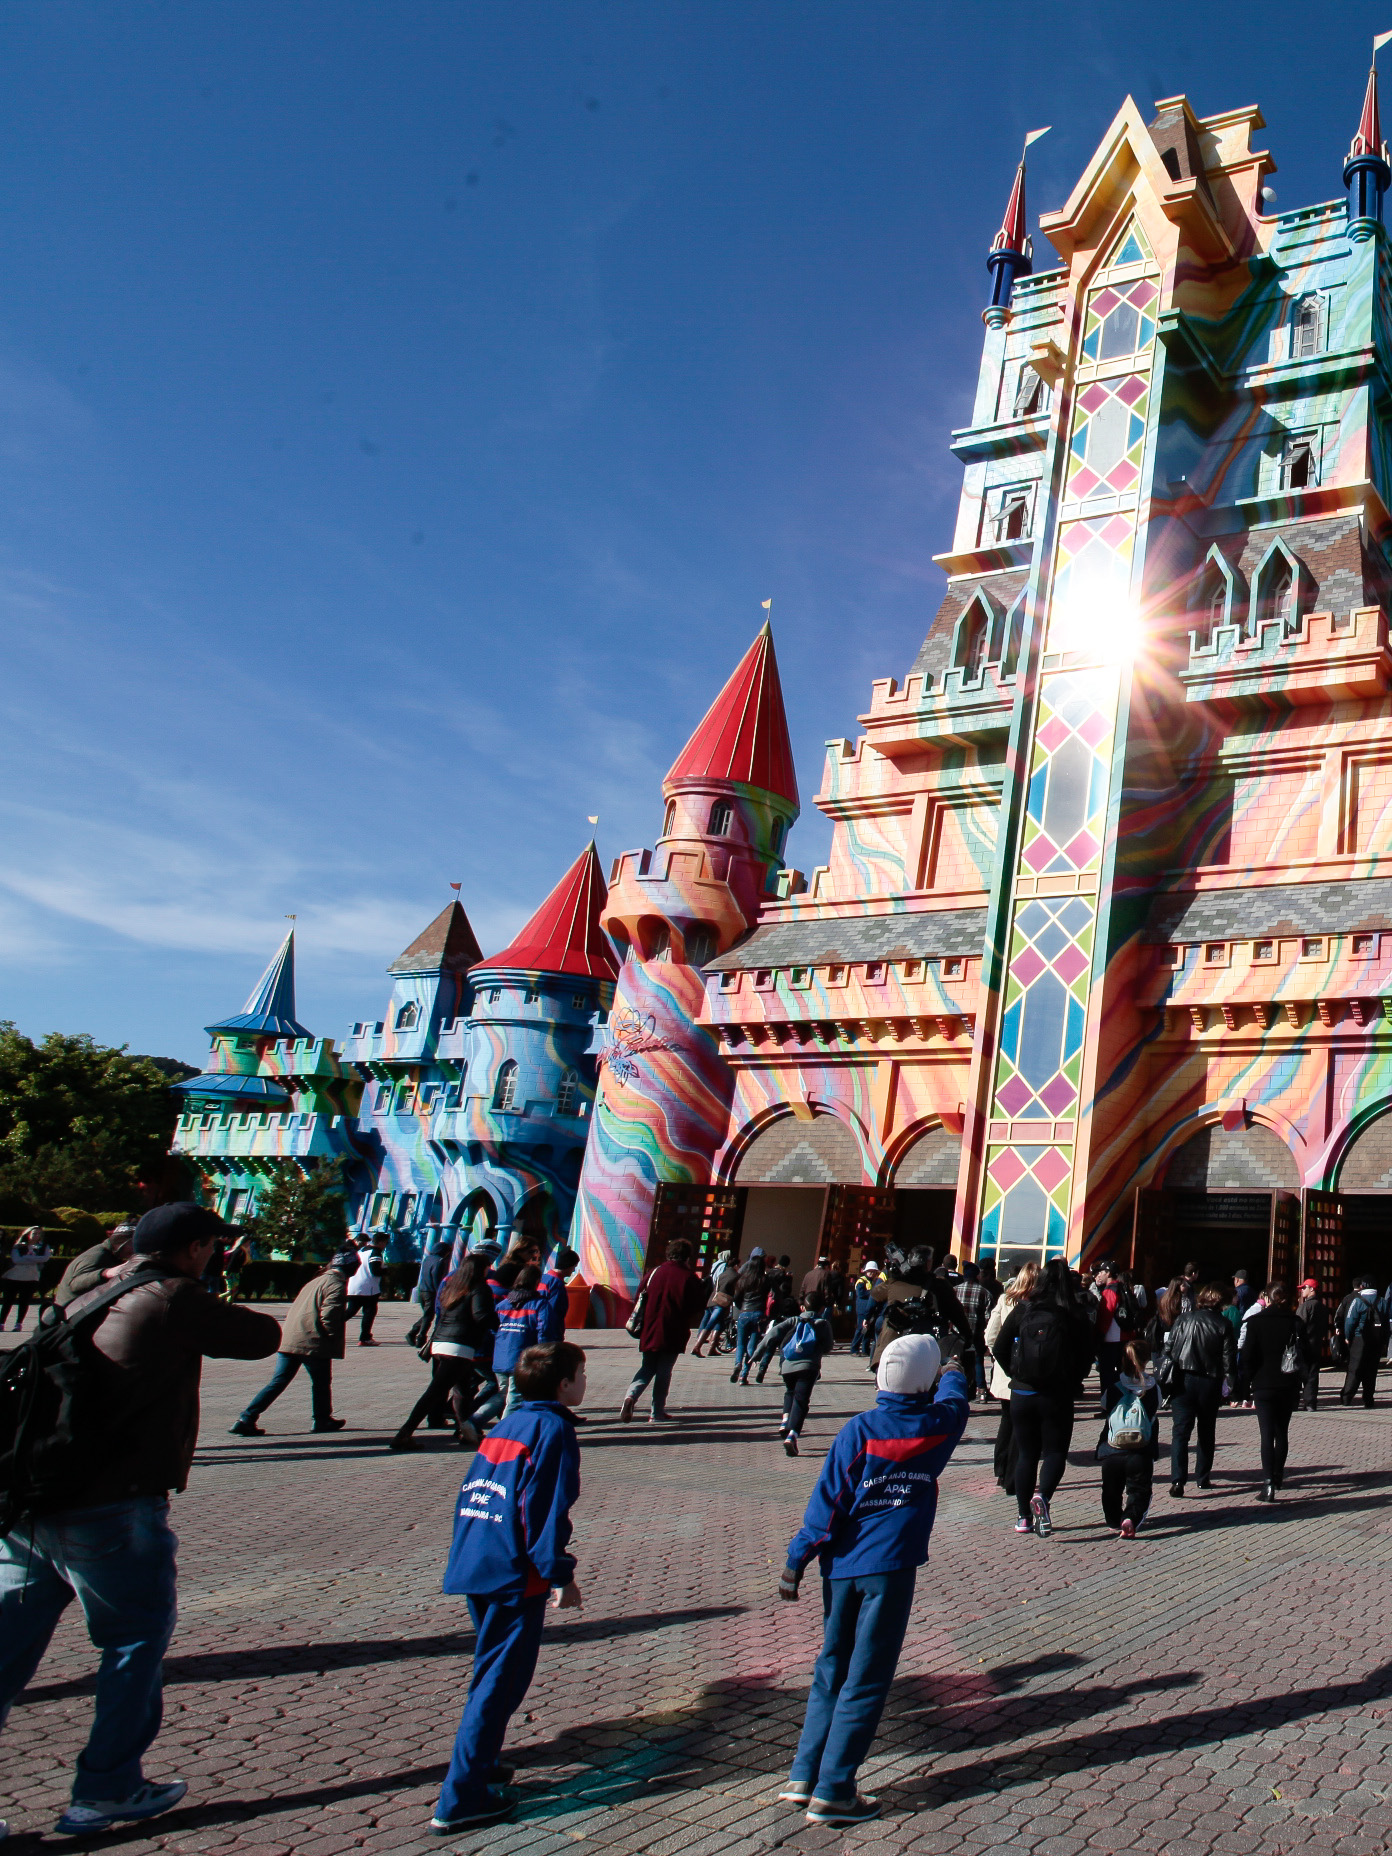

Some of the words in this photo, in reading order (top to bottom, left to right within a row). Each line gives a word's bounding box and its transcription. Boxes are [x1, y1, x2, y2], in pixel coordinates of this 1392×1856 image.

[863, 1475, 887, 1488] CAESP
[888, 1472, 907, 1480] ANJO
[908, 1472, 932, 1483] GABRIEL
[884, 1484, 912, 1494] APAE
